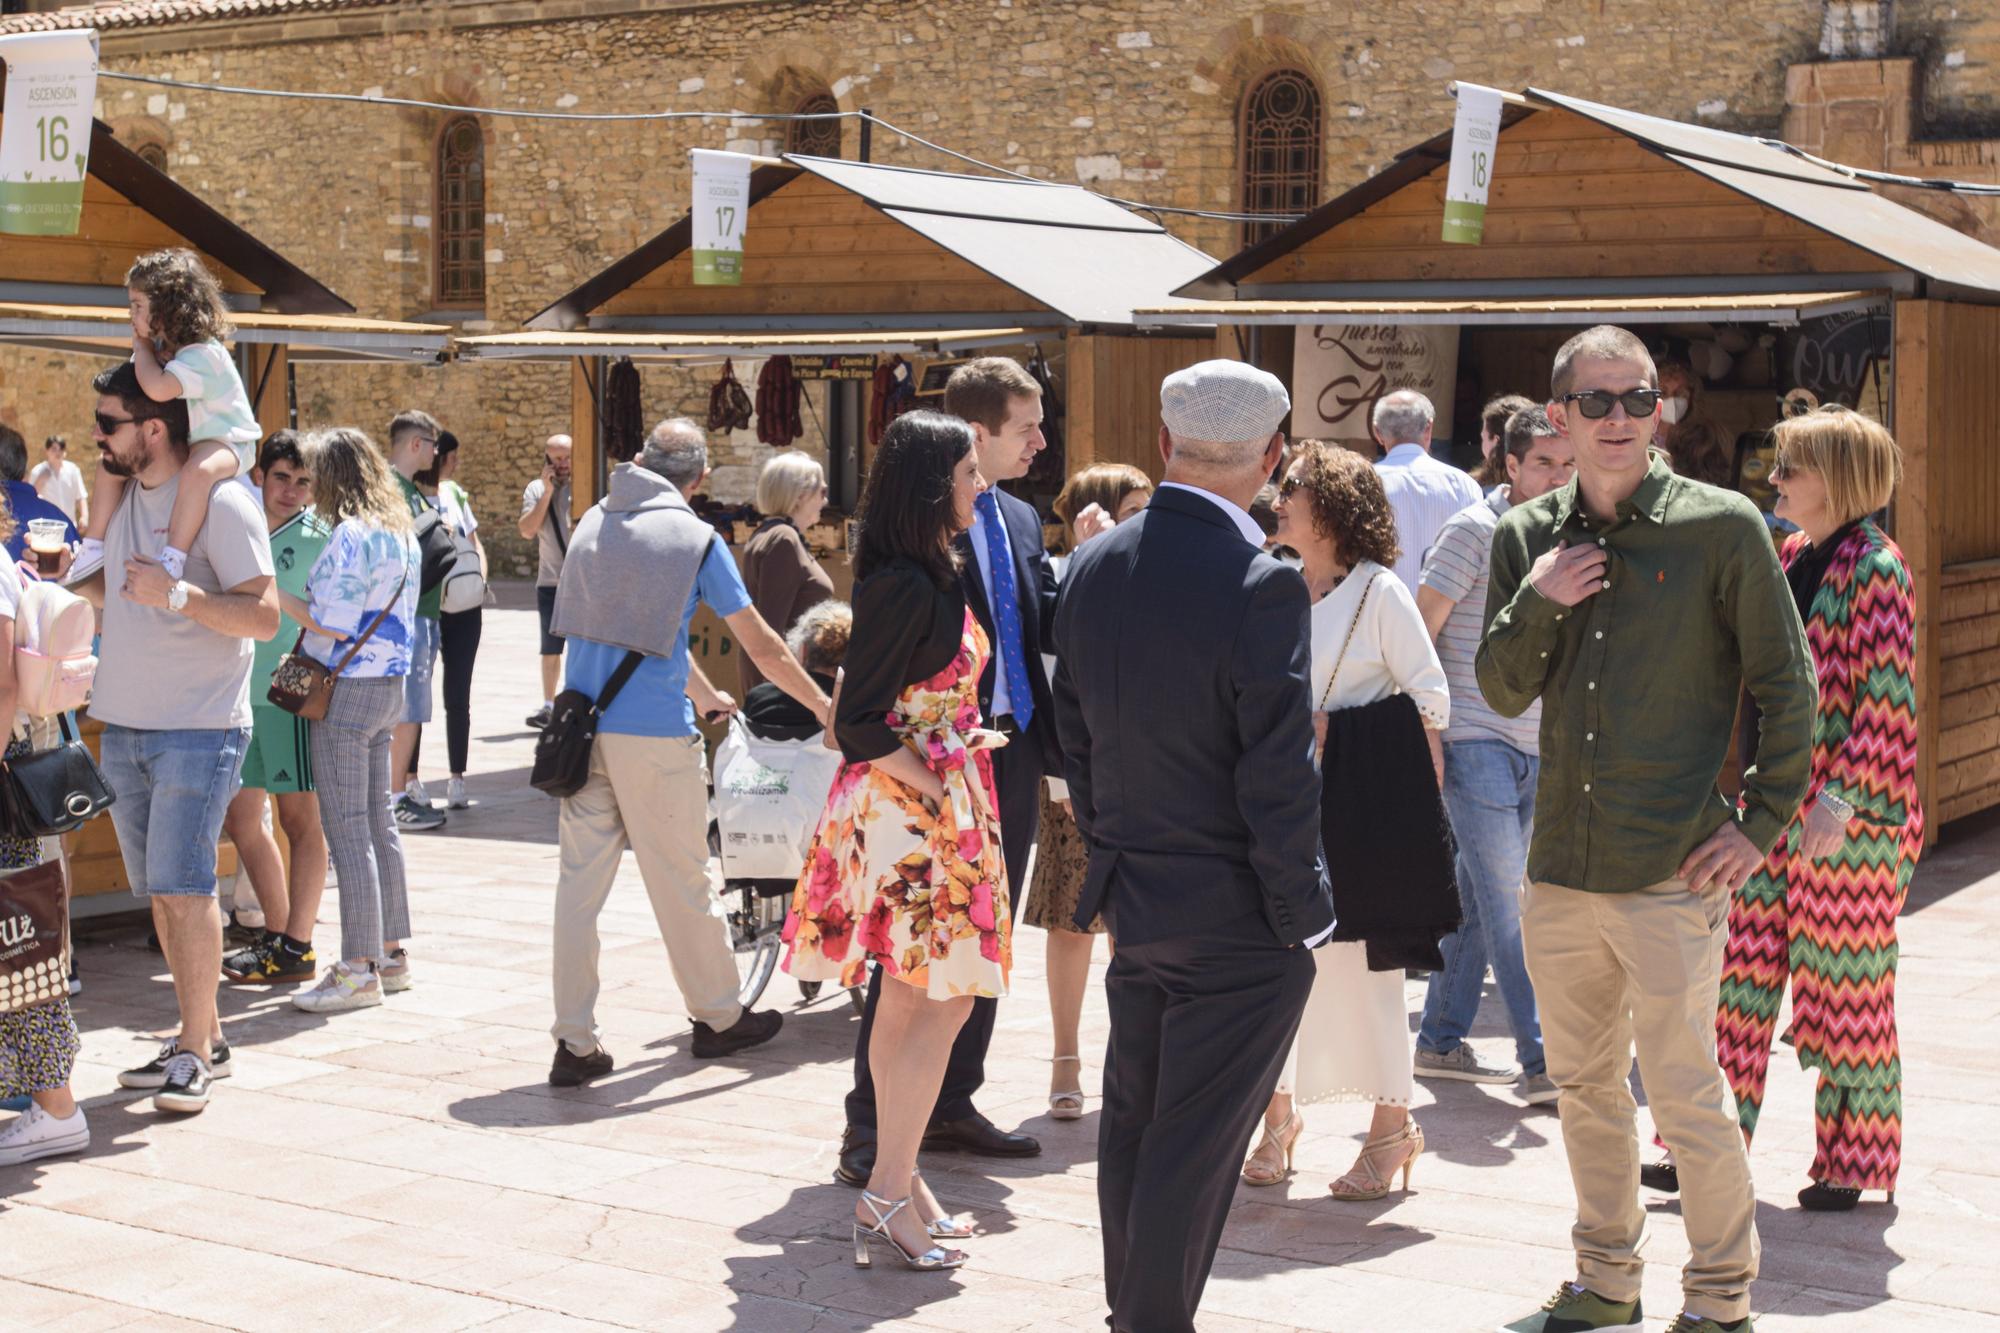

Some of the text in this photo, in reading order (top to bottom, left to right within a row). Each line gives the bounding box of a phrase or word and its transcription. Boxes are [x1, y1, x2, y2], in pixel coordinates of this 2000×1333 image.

[36, 115, 69, 162] 16
[1471, 151, 1487, 188] 18
[715, 206, 735, 237] 17
